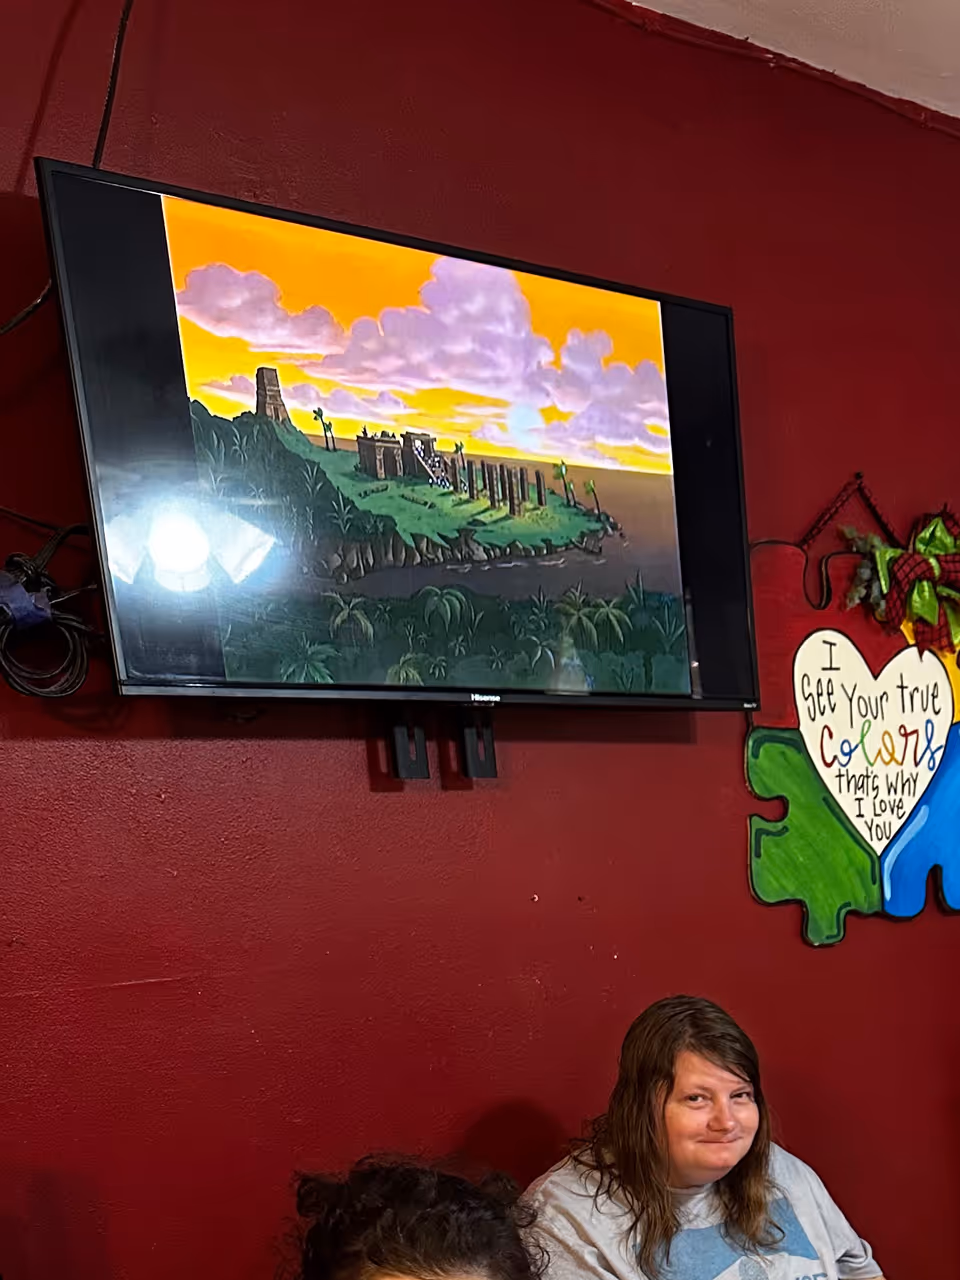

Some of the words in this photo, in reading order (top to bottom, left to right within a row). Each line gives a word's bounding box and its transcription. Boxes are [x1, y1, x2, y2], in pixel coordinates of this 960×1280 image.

[821, 640, 841, 671] I
[801, 674, 836, 722] See
[841, 683, 888, 728] Your
[896, 673, 942, 716] true
[820, 719, 944, 771] Colors
[835, 767, 879, 799] that's
[855, 798, 864, 818] I
